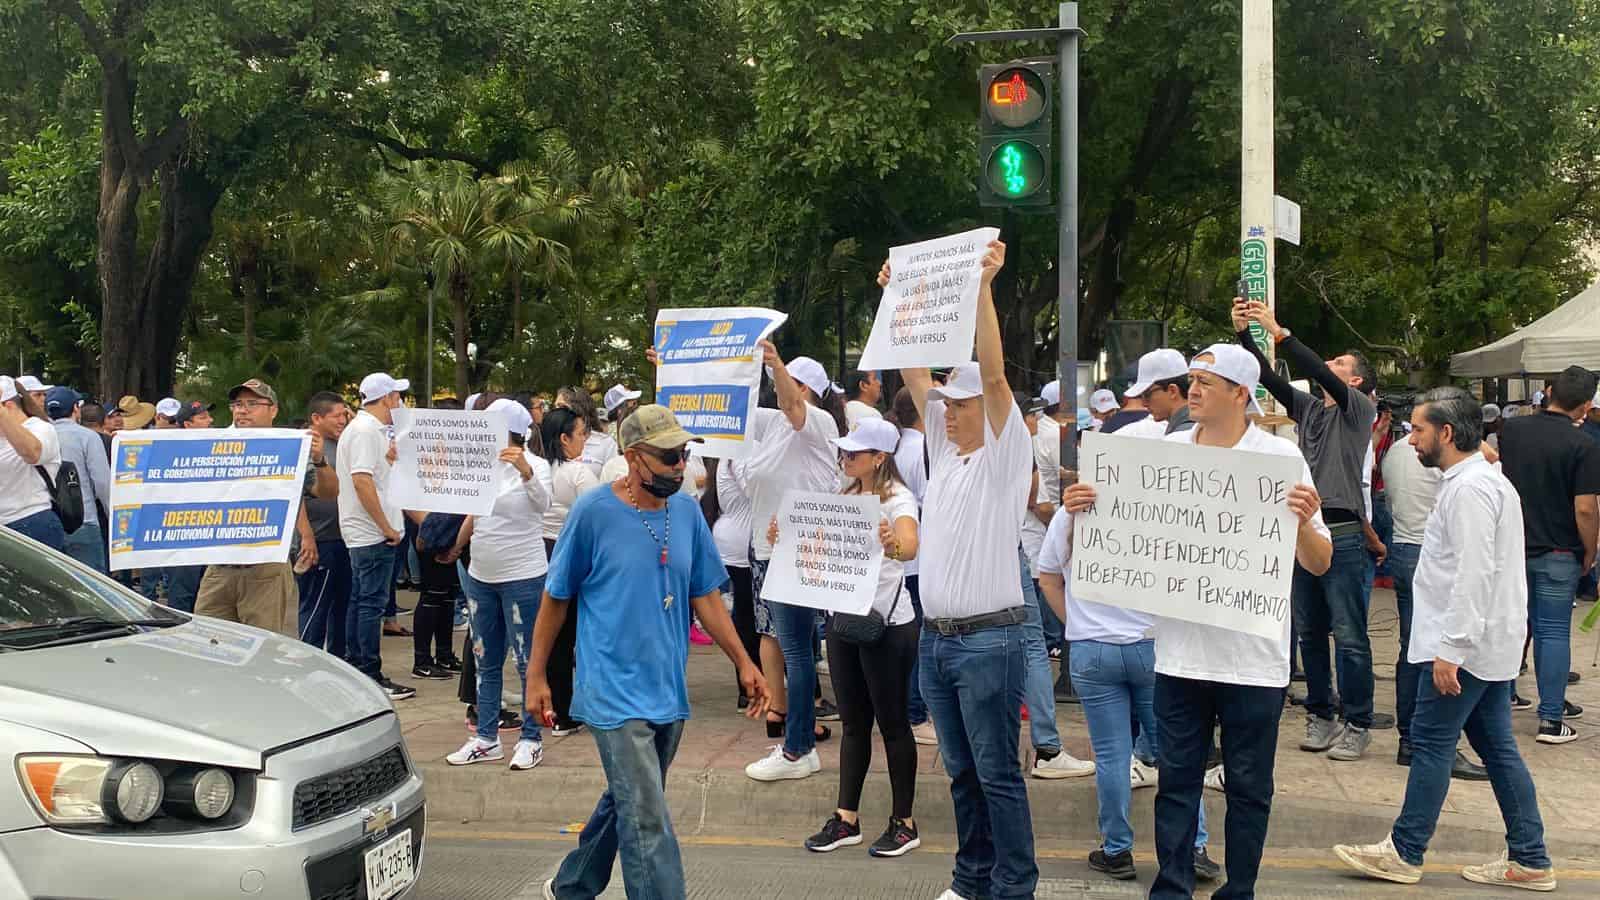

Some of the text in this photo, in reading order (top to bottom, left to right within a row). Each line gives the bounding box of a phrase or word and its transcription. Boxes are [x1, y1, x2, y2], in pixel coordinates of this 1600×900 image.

[909, 242, 975, 264] JUNTOS SOMOS MÁS
[897, 271, 909, 282] QUE
[946, 259, 976, 271] FUERTES
[902, 288, 909, 297] LA
[911, 285, 920, 296] UAS
[922, 282, 940, 294] UNIDA
[912, 299, 937, 311] VENCIDA
[938, 294, 961, 306] SOMOS
[890, 312, 958, 328] GRANDES SOMOS UAS
[891, 332, 947, 346] SURSUM VERSUS
[416, 419, 440, 427] JUNTOS
[471, 418, 488, 428] MÁS
[448, 432, 464, 440] MÁS
[465, 434, 496, 442] FUERTES
[211, 441, 246, 455] ¡ALTO!
[442, 446, 464, 454] UNIDA
[465, 445, 490, 455] JAMÁS
[173, 457, 180, 467] A
[181, 457, 191, 467] LA
[245, 452, 279, 464] POLÍTICA
[434, 459, 464, 467] VENCIDA
[466, 460, 492, 469] SOMOS
[148, 469, 162, 479] DEL
[164, 468, 213, 478] GOBERNADOR
[215, 467, 227, 478] EN
[228, 466, 257, 477] CONTRA
[260, 466, 270, 476] DE
[271, 465, 282, 475] LA
[283, 465, 297, 475] UA
[417, 471, 490, 482] GRANDES SOMOS UAS
[424, 486, 479, 496] SURSUM VERSUS
[1140, 464, 1238, 502] DEFENSA
[1258, 474, 1287, 504] DE
[794, 501, 818, 511] JUNTOS
[819, 503, 844, 513] SOMOS
[163, 507, 269, 527] ¡DEFENSA TOTAL!
[790, 515, 804, 524] QUE
[843, 519, 872, 530] FUERTES
[1111, 496, 1206, 534] AUTONOMÍA
[1218, 511, 1246, 534] DE
[1260, 516, 1281, 542] LA
[144, 525, 278, 542] A LA AUTONOMÍA UNIVERSITARIA
[798, 530, 866, 545] LA UAS UNIDA JAMÁS
[813, 545, 843, 557] VENCIDA
[844, 549, 870, 560] SOMOS
[1132, 534, 1250, 572] DEFENDEMOS
[1262, 554, 1280, 579] LA
[795, 560, 867, 576] GRANDES SOMOS UAS
[1077, 559, 1156, 589] LIBERTAD
[1167, 576, 1187, 594] DE
[800, 577, 856, 592] SURSUM VERSUS
